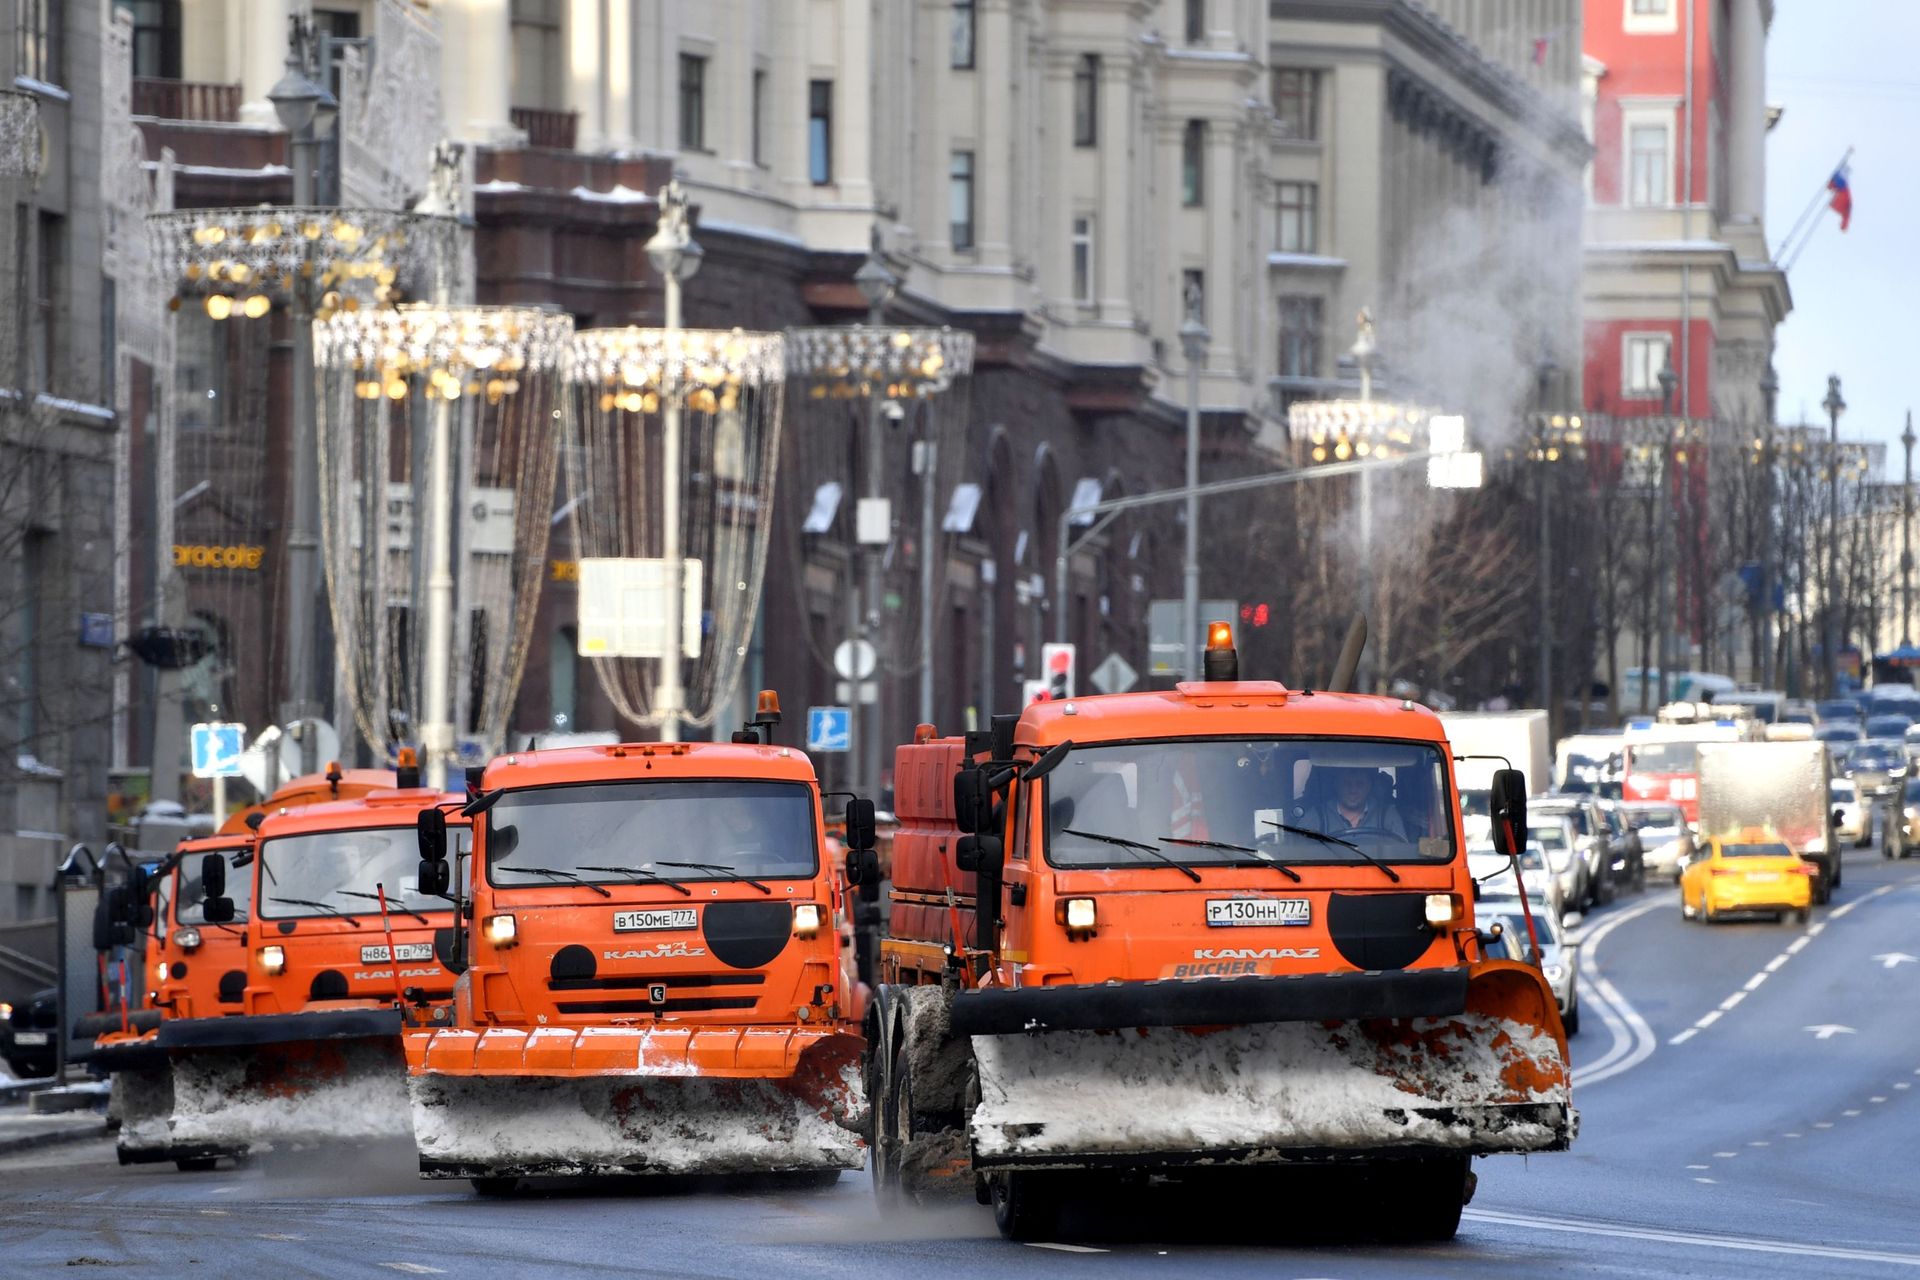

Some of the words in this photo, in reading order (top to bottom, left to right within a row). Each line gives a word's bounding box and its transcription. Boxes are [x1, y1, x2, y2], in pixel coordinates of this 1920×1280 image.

[1280, 901, 1305, 913] 777
[673, 911, 693, 921] 777
[365, 948, 410, 959] Н86ТВ
[603, 948, 705, 959] KAMAZ
[1194, 948, 1320, 959] KAMAZ
[1174, 961, 1258, 977] BUCHER
